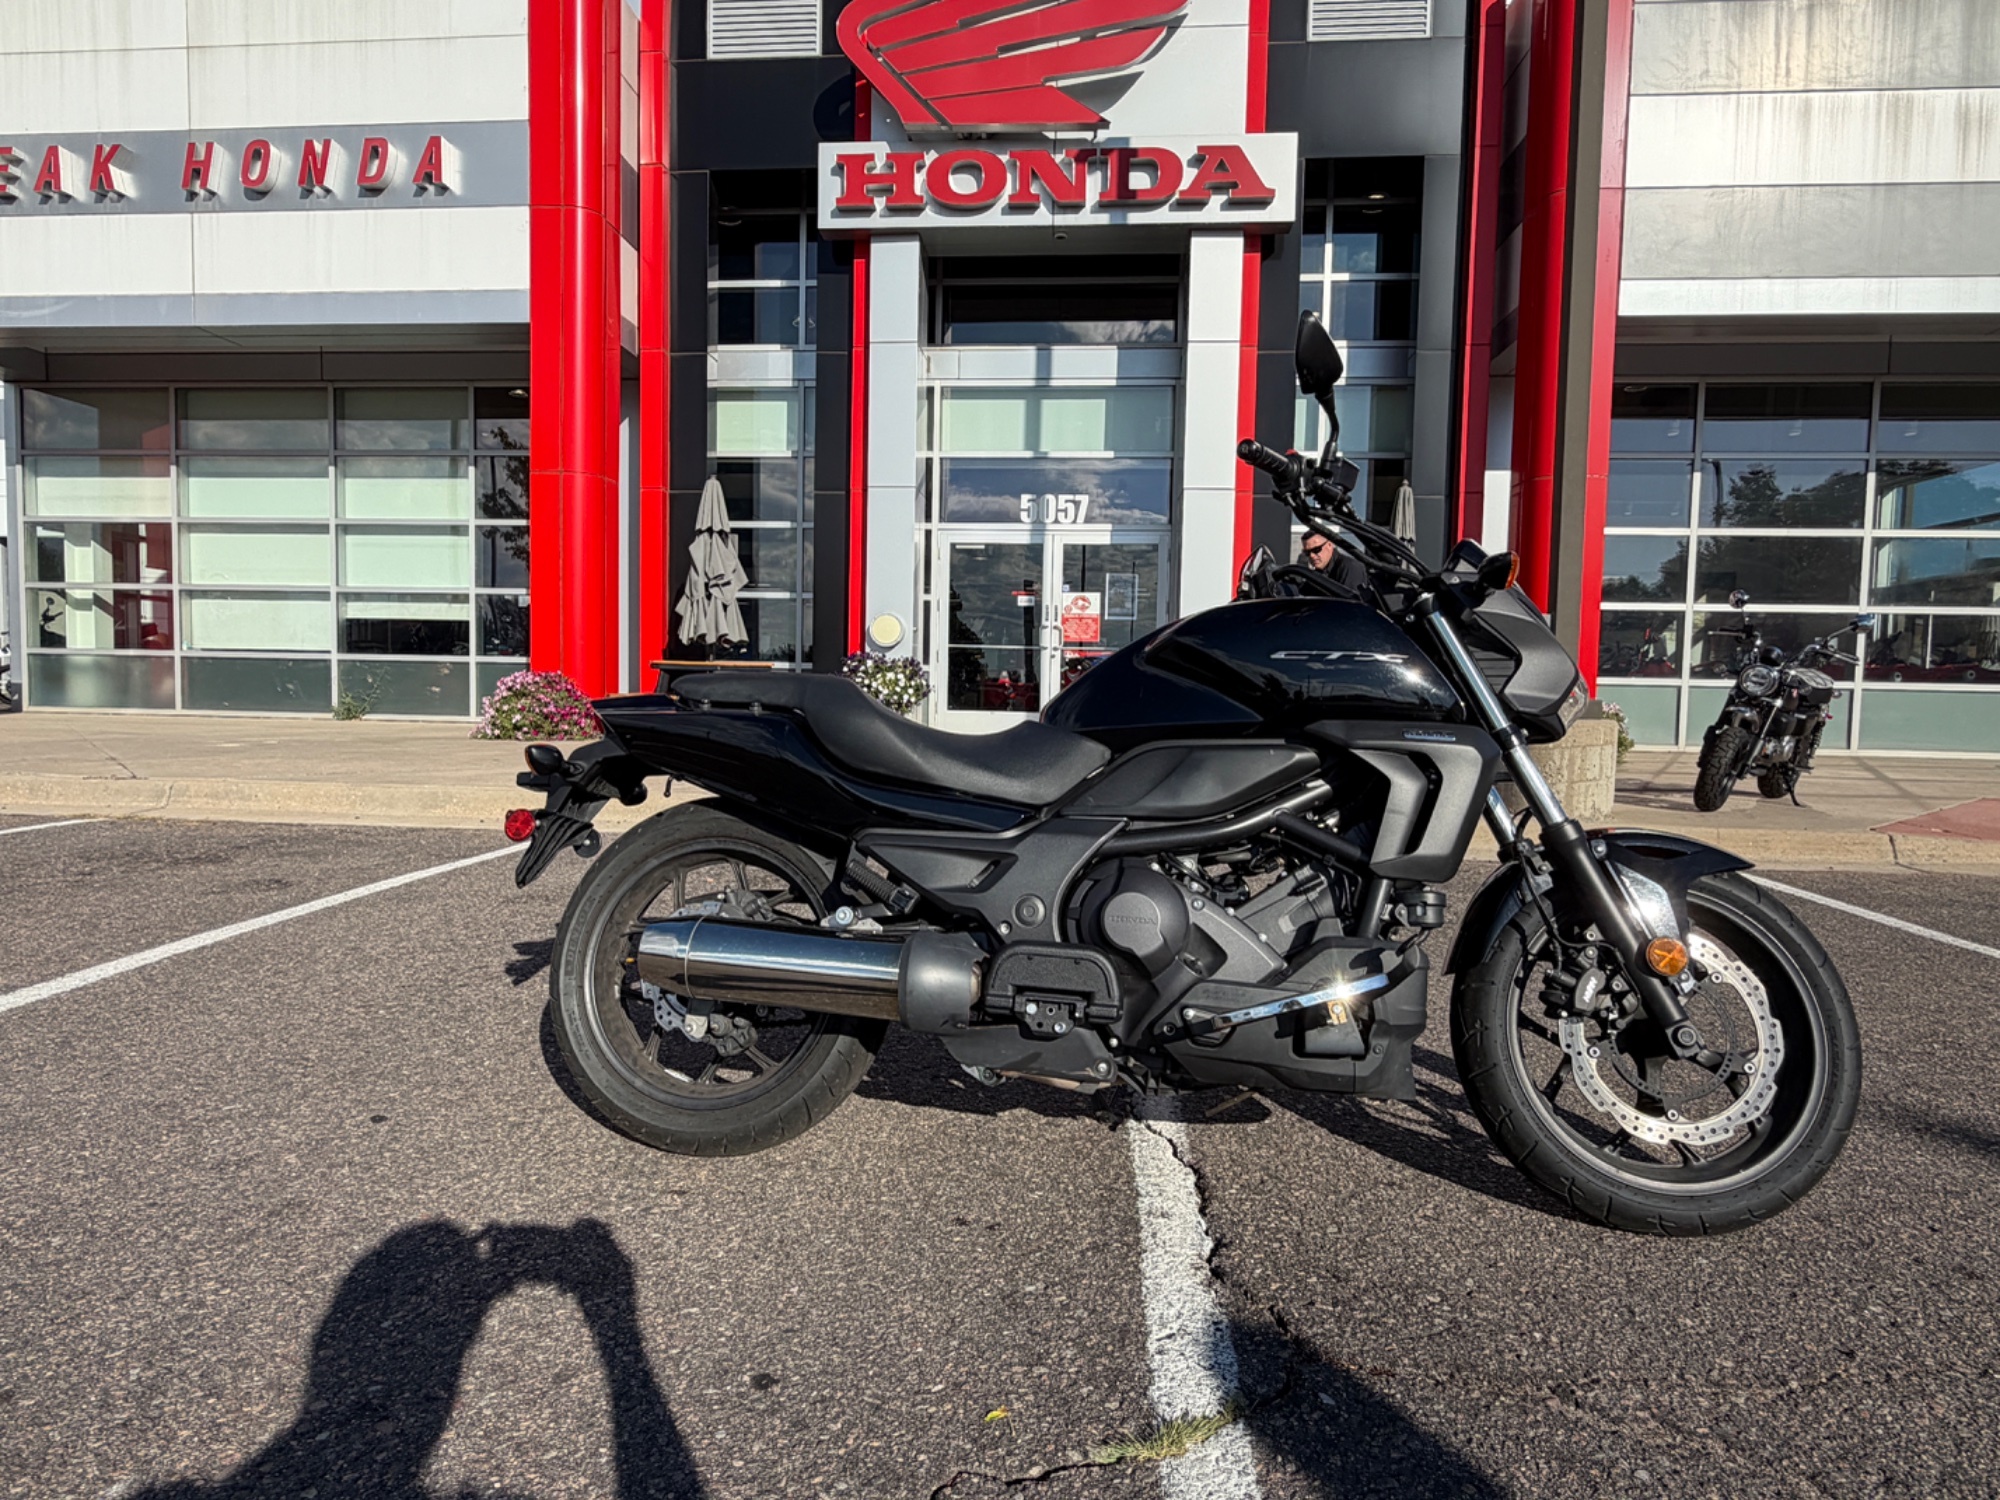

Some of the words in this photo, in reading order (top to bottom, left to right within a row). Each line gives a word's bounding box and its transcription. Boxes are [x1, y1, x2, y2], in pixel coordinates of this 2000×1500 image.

[181, 135, 443, 190] HONDA
[835, 145, 1276, 209] HONDA
[1020, 493, 1089, 524] 5057
[1270, 650, 1409, 663] CTX
[1108, 915, 1157, 925] HONDA
